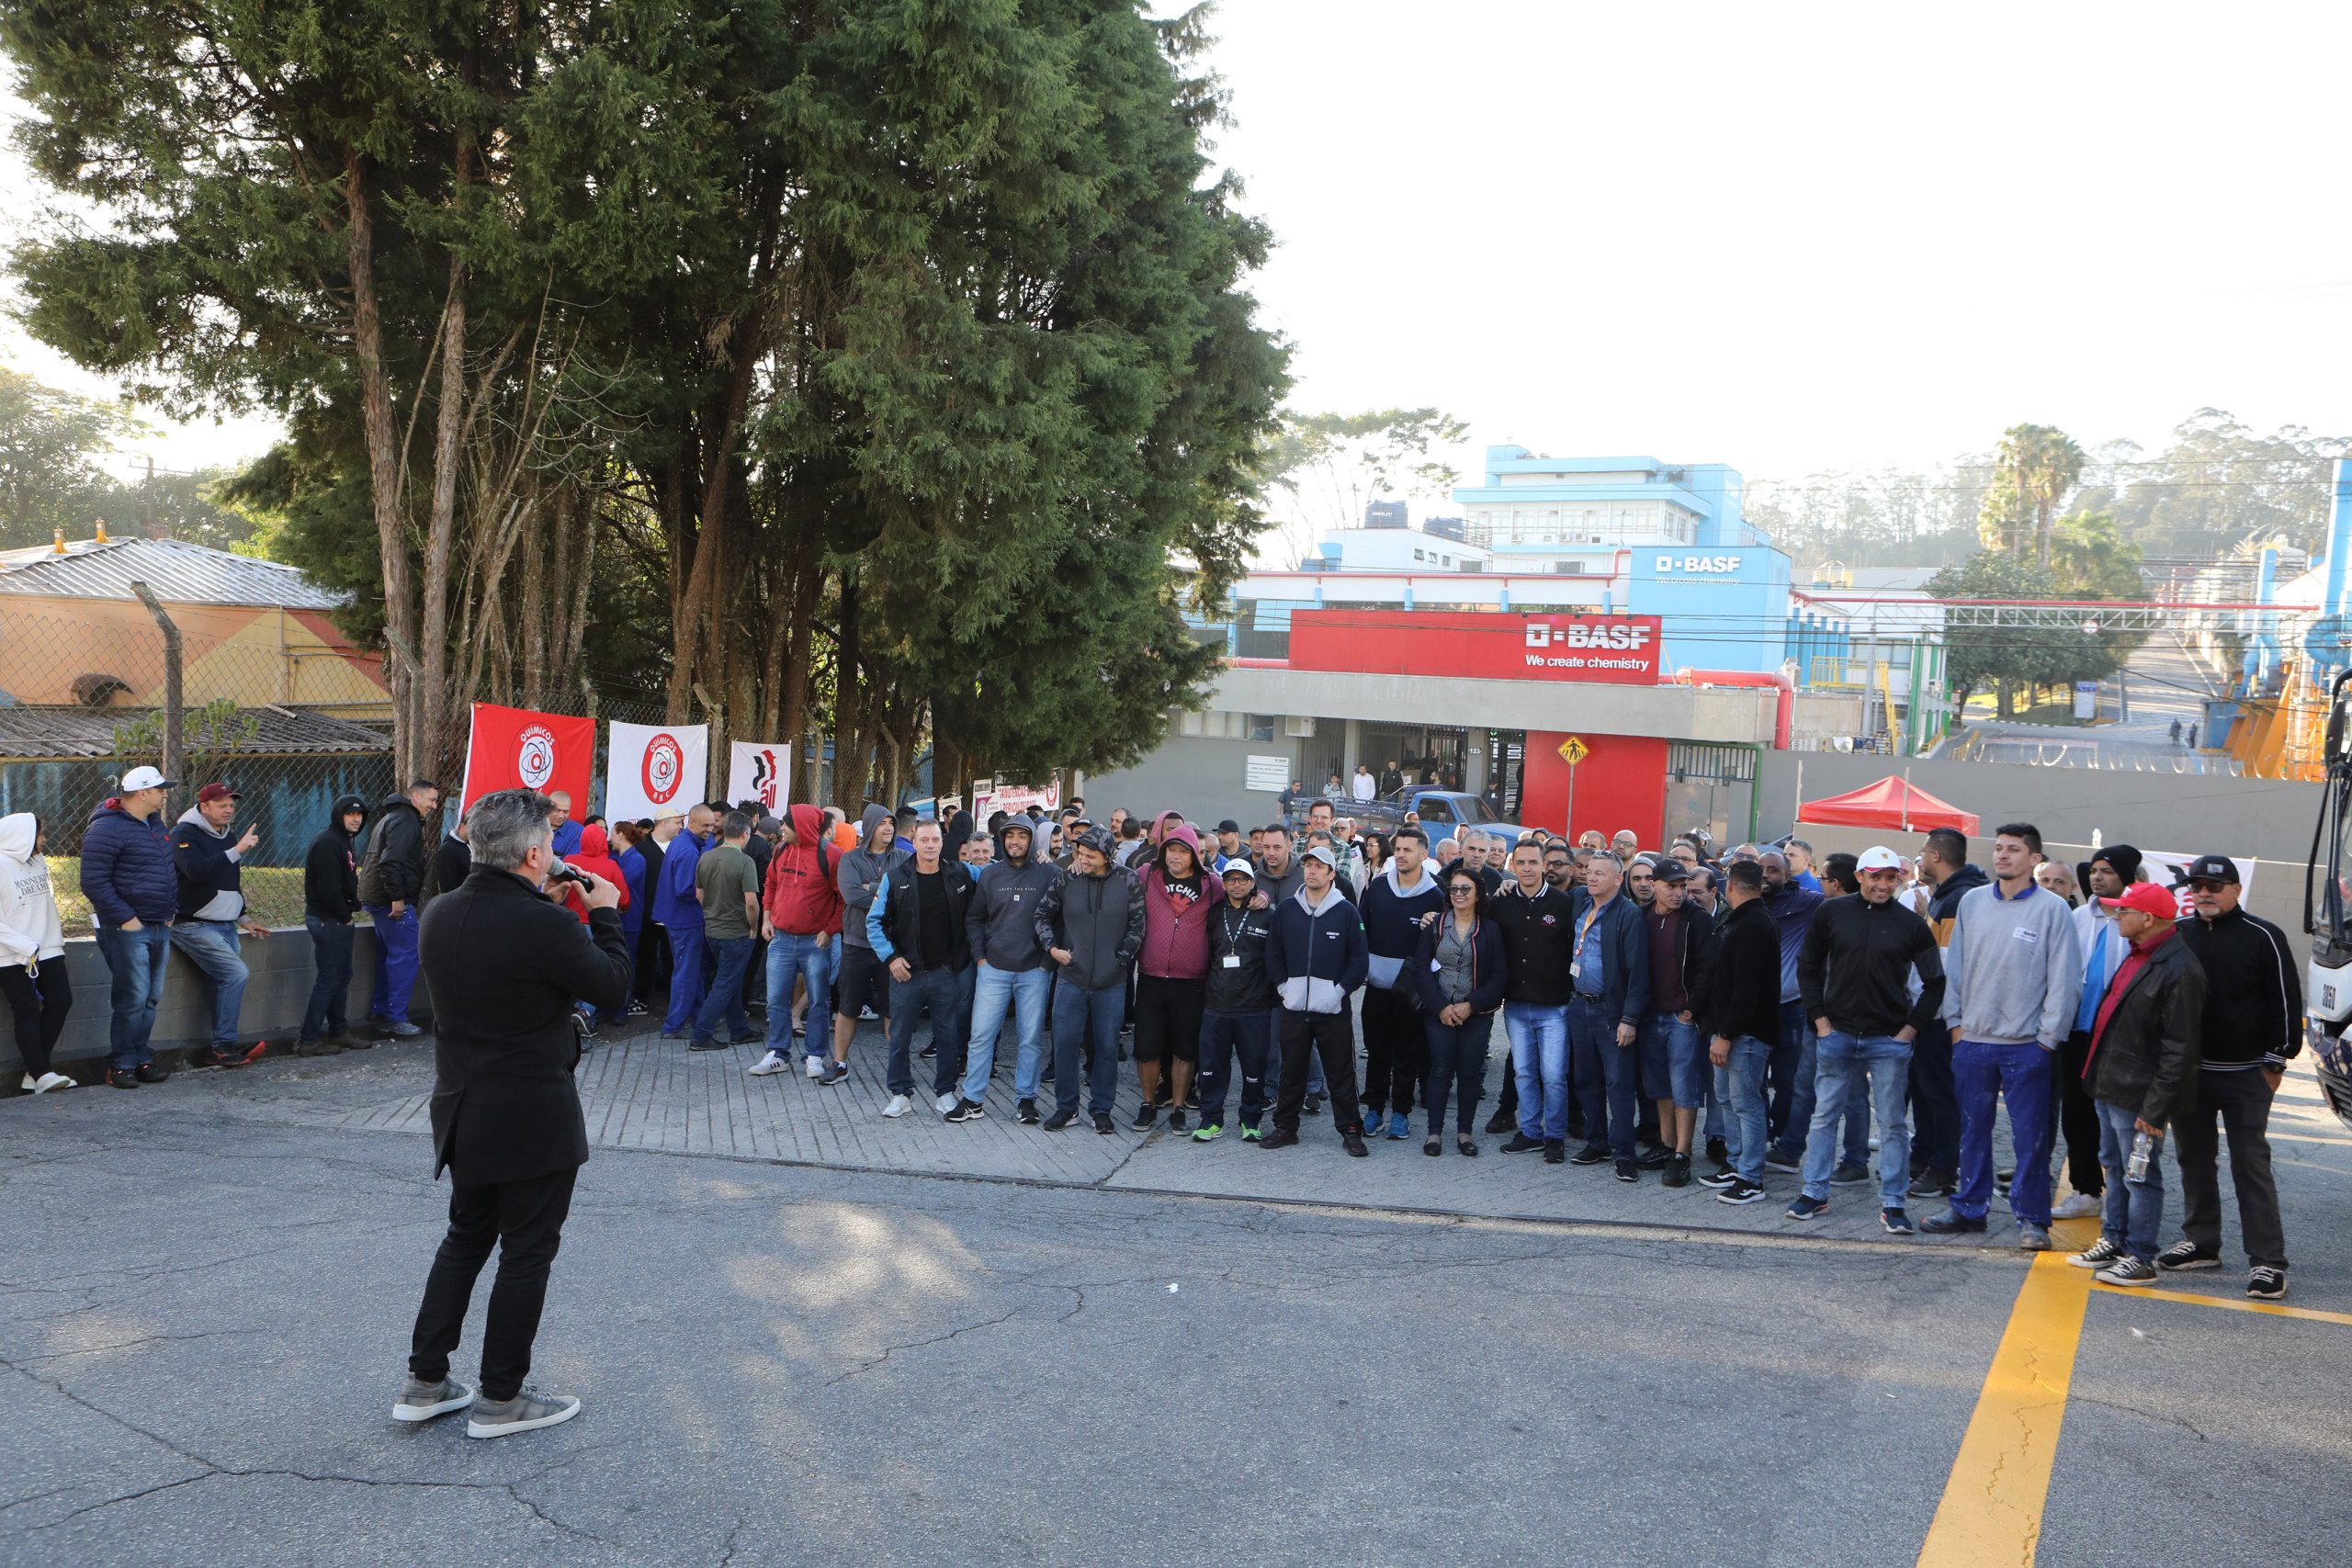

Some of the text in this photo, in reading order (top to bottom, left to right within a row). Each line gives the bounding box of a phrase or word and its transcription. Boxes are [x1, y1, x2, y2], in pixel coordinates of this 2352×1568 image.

[1684, 556, 1741, 573] BASF
[1657, 576, 1741, 587] We create chemistry
[1567, 624, 1651, 649] BASF
[1525, 654, 1649, 672] We create chemistry
[520, 724, 555, 746] QUÍMICOS
[650, 736, 677, 753] QUÍMICOS
[653, 791, 670, 802] ABC
